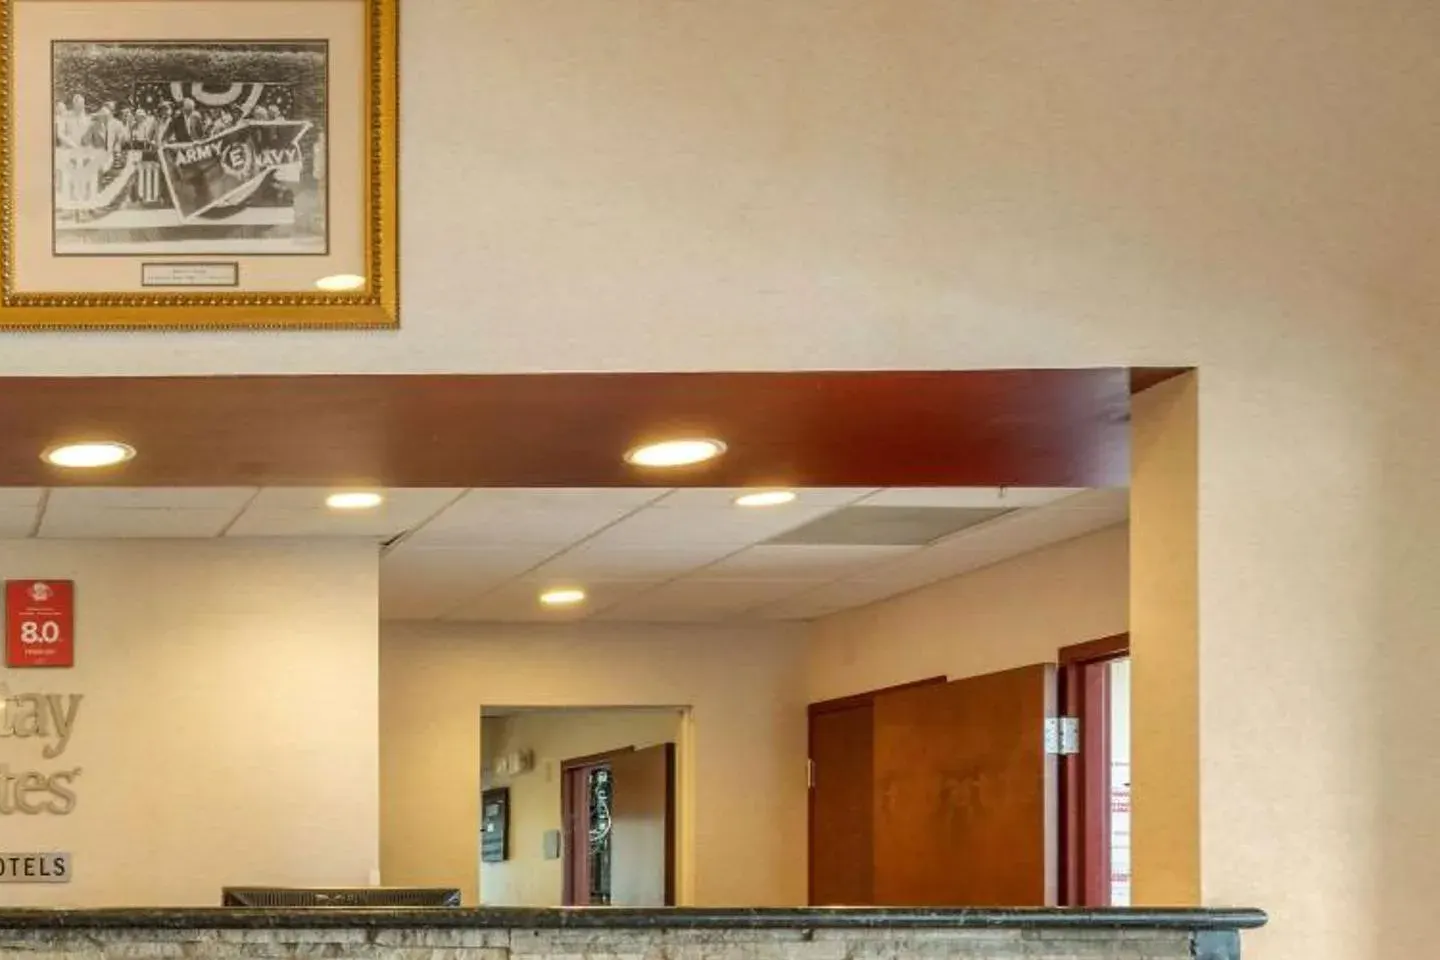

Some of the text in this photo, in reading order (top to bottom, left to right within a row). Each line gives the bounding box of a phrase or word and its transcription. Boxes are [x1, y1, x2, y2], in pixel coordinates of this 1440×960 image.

[176, 139, 223, 167] ARMY
[254, 148, 296, 166] NAVY
[20, 620, 61, 644] 8.0
